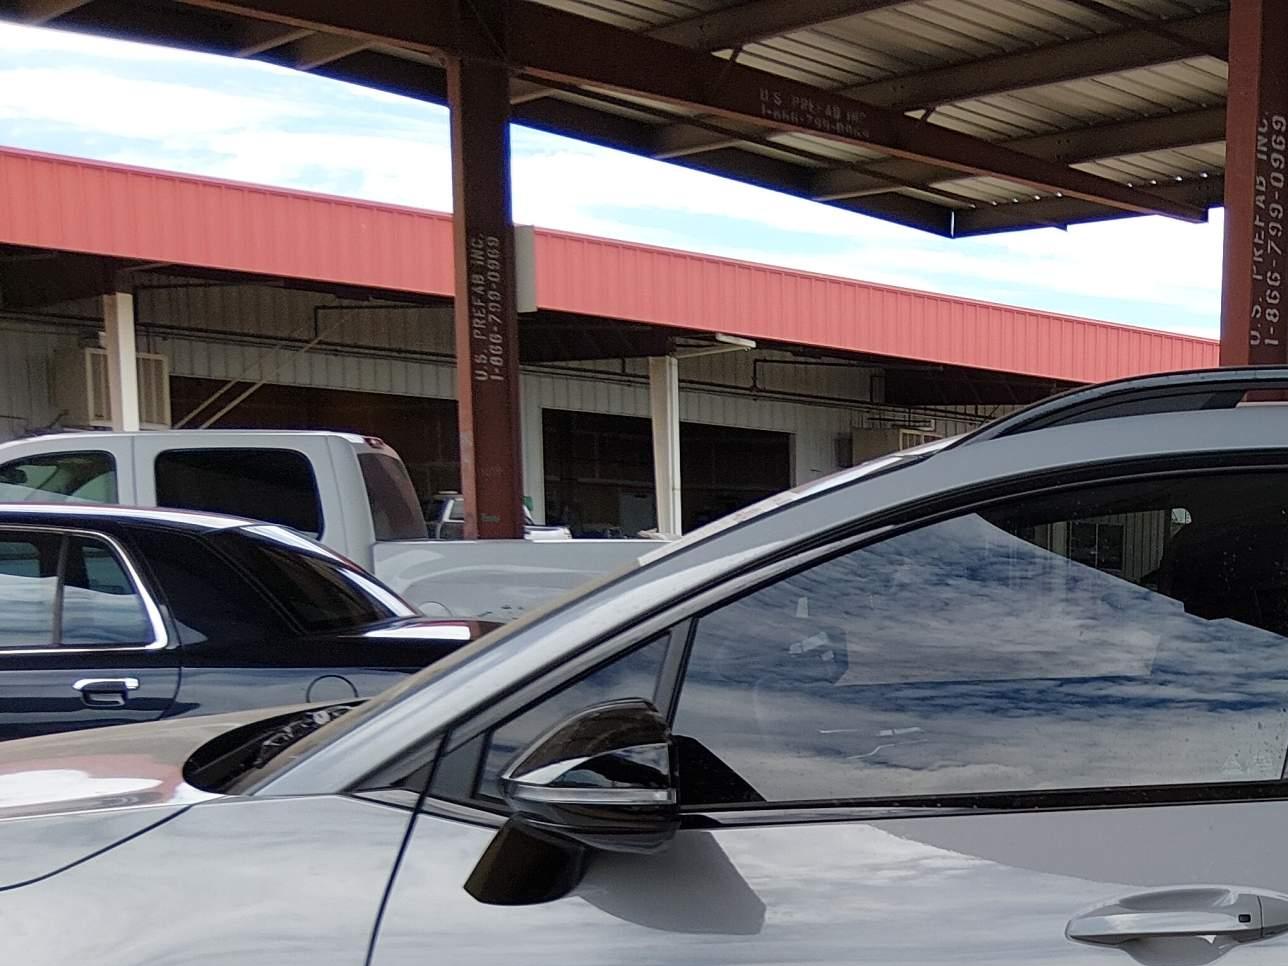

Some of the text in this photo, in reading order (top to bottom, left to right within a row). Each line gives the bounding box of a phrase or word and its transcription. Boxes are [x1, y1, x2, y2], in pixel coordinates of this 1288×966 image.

[1264, 114, 1286, 346] 1-866-799-0969
[471, 274, 487, 340] PREFAB
[474, 348, 489, 381] U.S.
